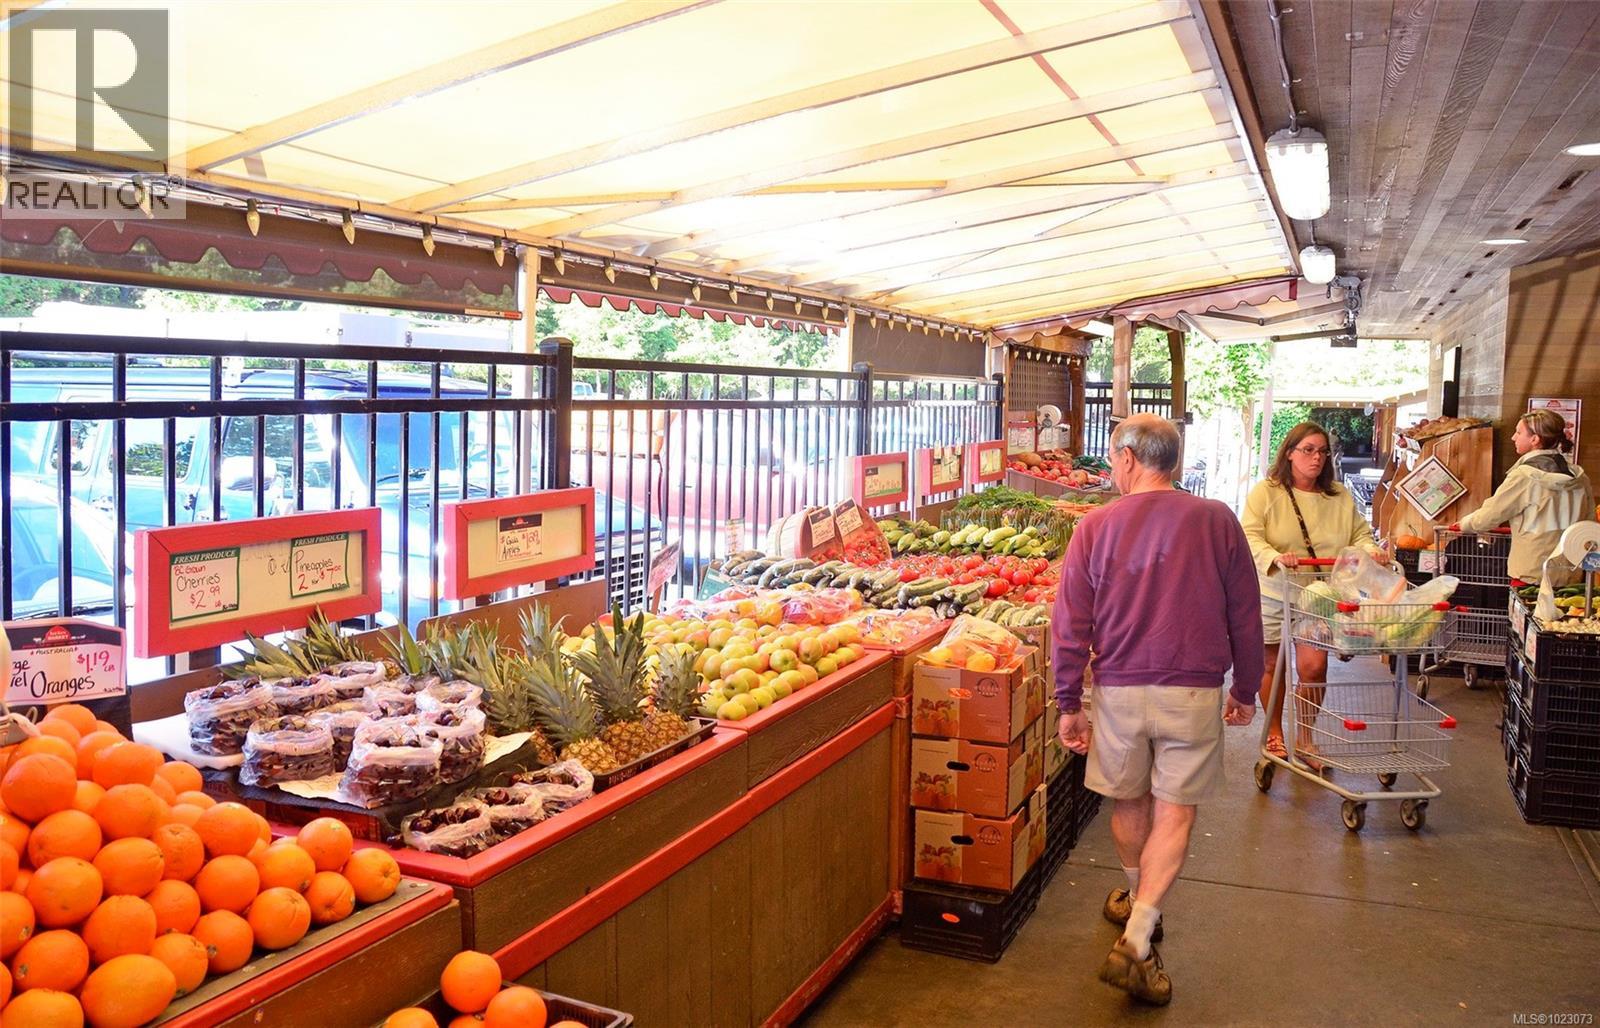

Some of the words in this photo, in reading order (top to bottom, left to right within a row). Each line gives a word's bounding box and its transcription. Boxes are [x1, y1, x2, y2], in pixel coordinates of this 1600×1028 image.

[295, 538, 315, 546] FRESH
[316, 534, 345, 543] PRODUCE
[174, 554, 199, 563] FRESH
[201, 550, 236, 561] PRODUCE
[294, 550, 333, 573] Pineapples
[176, 573, 221, 592] Cherries
[298, 574, 308, 591] 2
[31, 671, 95, 698] Oranges
